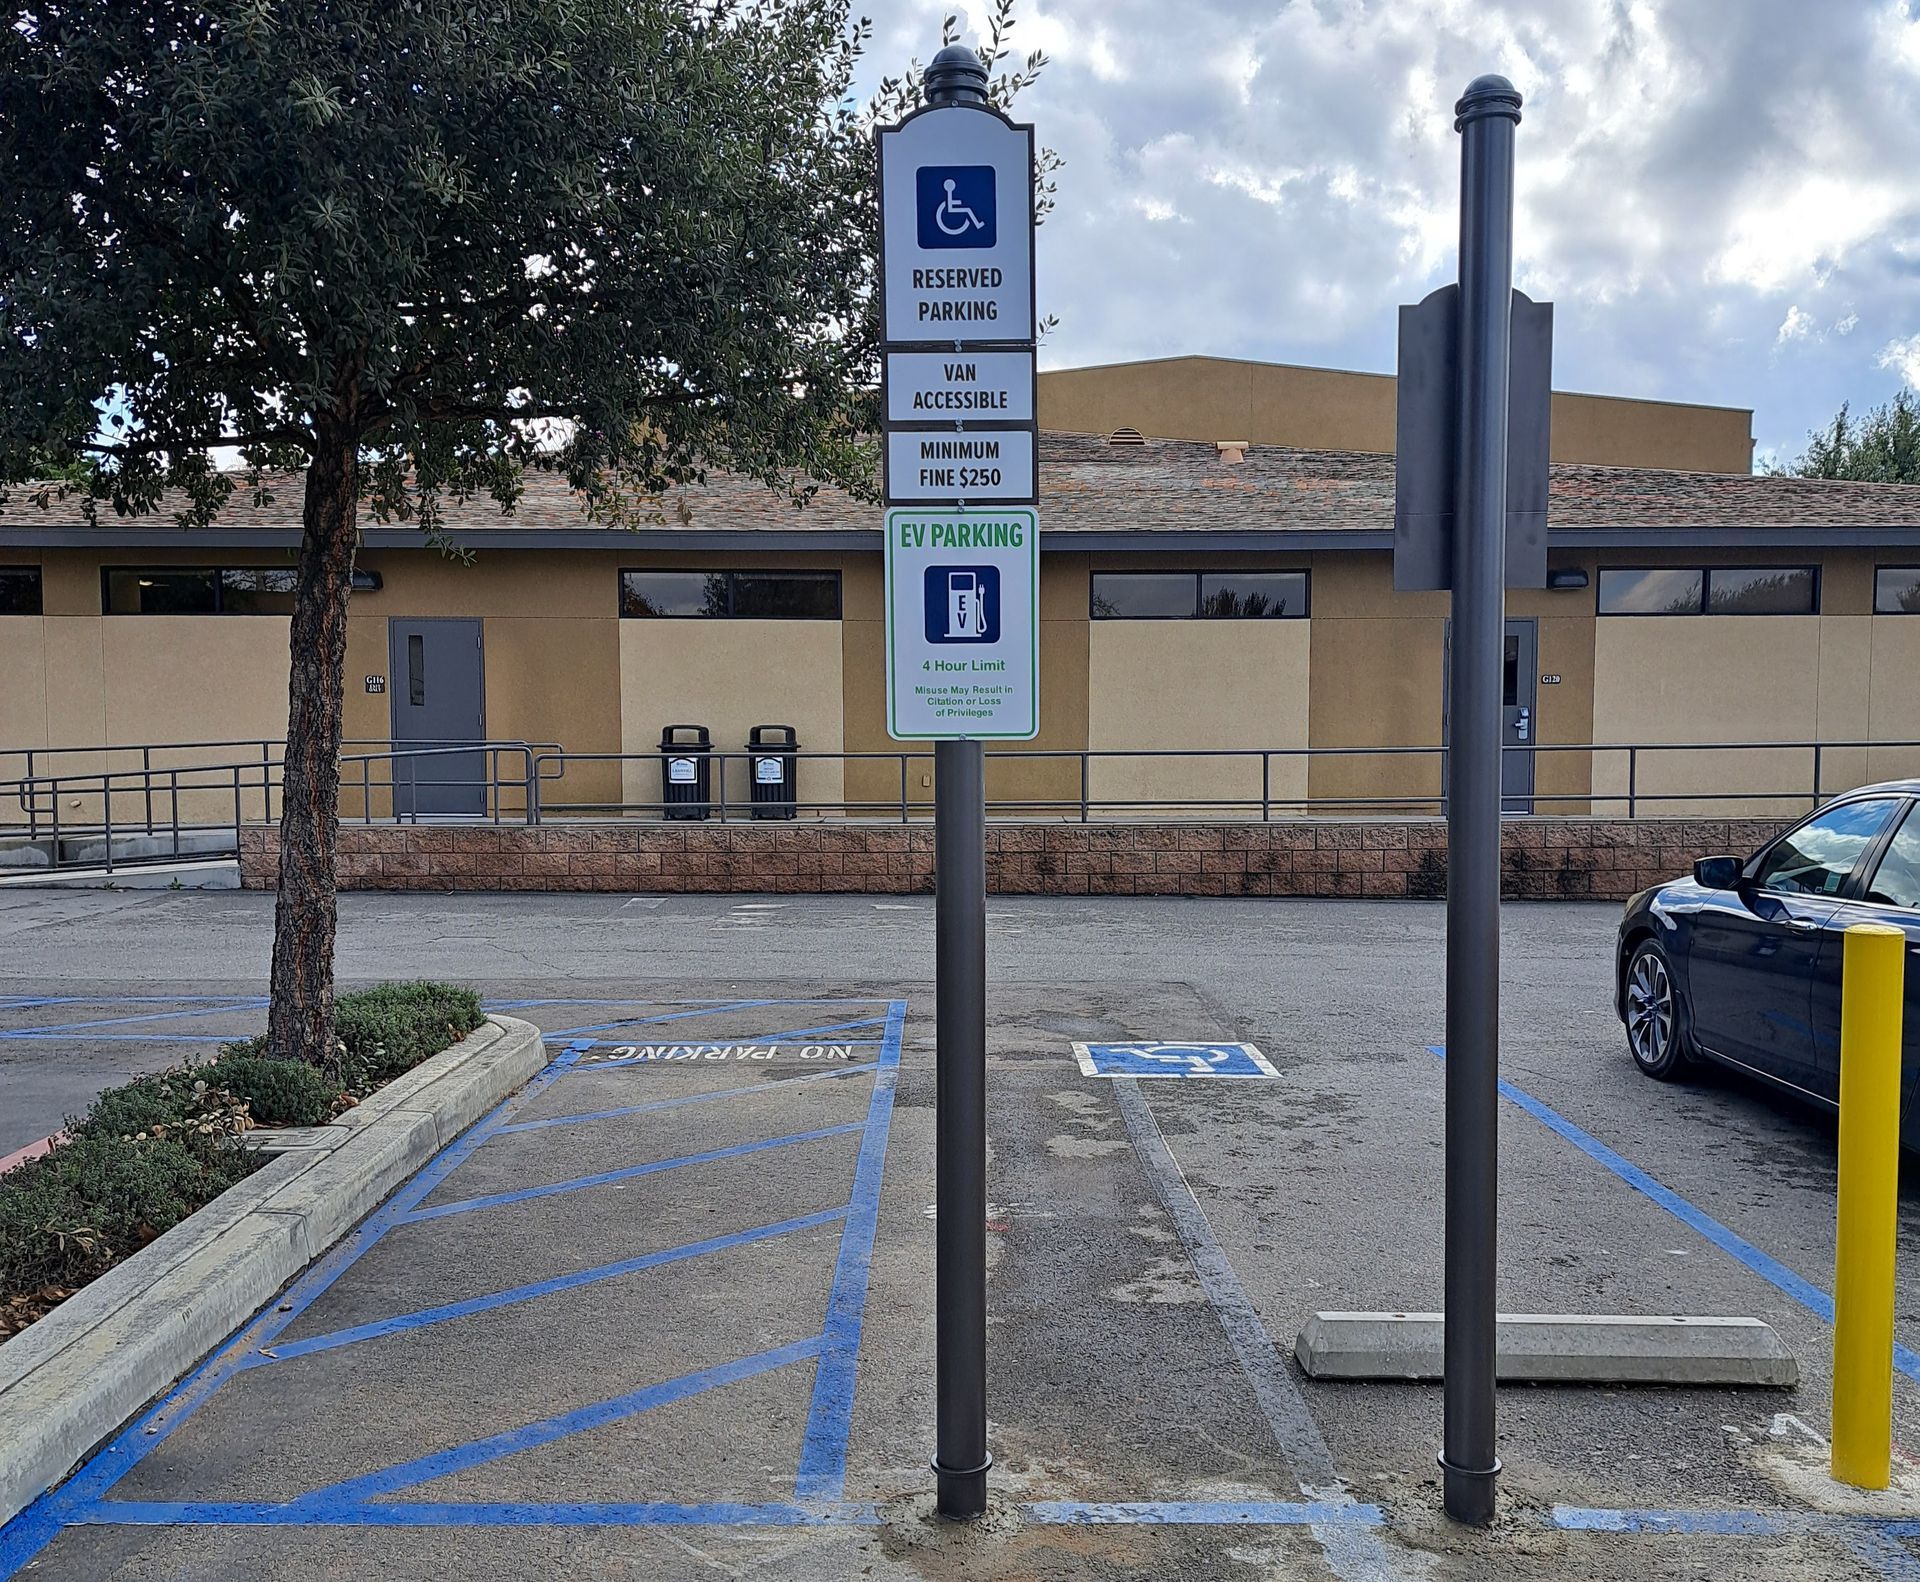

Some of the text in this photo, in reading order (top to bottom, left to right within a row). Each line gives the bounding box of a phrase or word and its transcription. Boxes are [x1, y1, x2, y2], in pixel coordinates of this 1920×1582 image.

[913, 268, 1002, 289] RESERVED
[919, 301, 998, 321] PARKING
[944, 364, 976, 381] VAN
[913, 391, 1008, 409] ACCESSIBLE
[921, 441, 999, 459] MINIMUM
[920, 467, 1001, 488] FINE $250
[901, 523, 1023, 548] EV PARKING
[922, 660, 1006, 671] 4 Hour Limit
[366, 676, 385, 684] G116
[915, 686, 948, 694] Misuse
[950, 686, 969, 696] May
[973, 685, 1002, 694] Result
[927, 697, 1001, 706] Citation or Loss
[935, 708, 993, 718] of Privileges
[608, 1045, 853, 1060] NO PARKING
